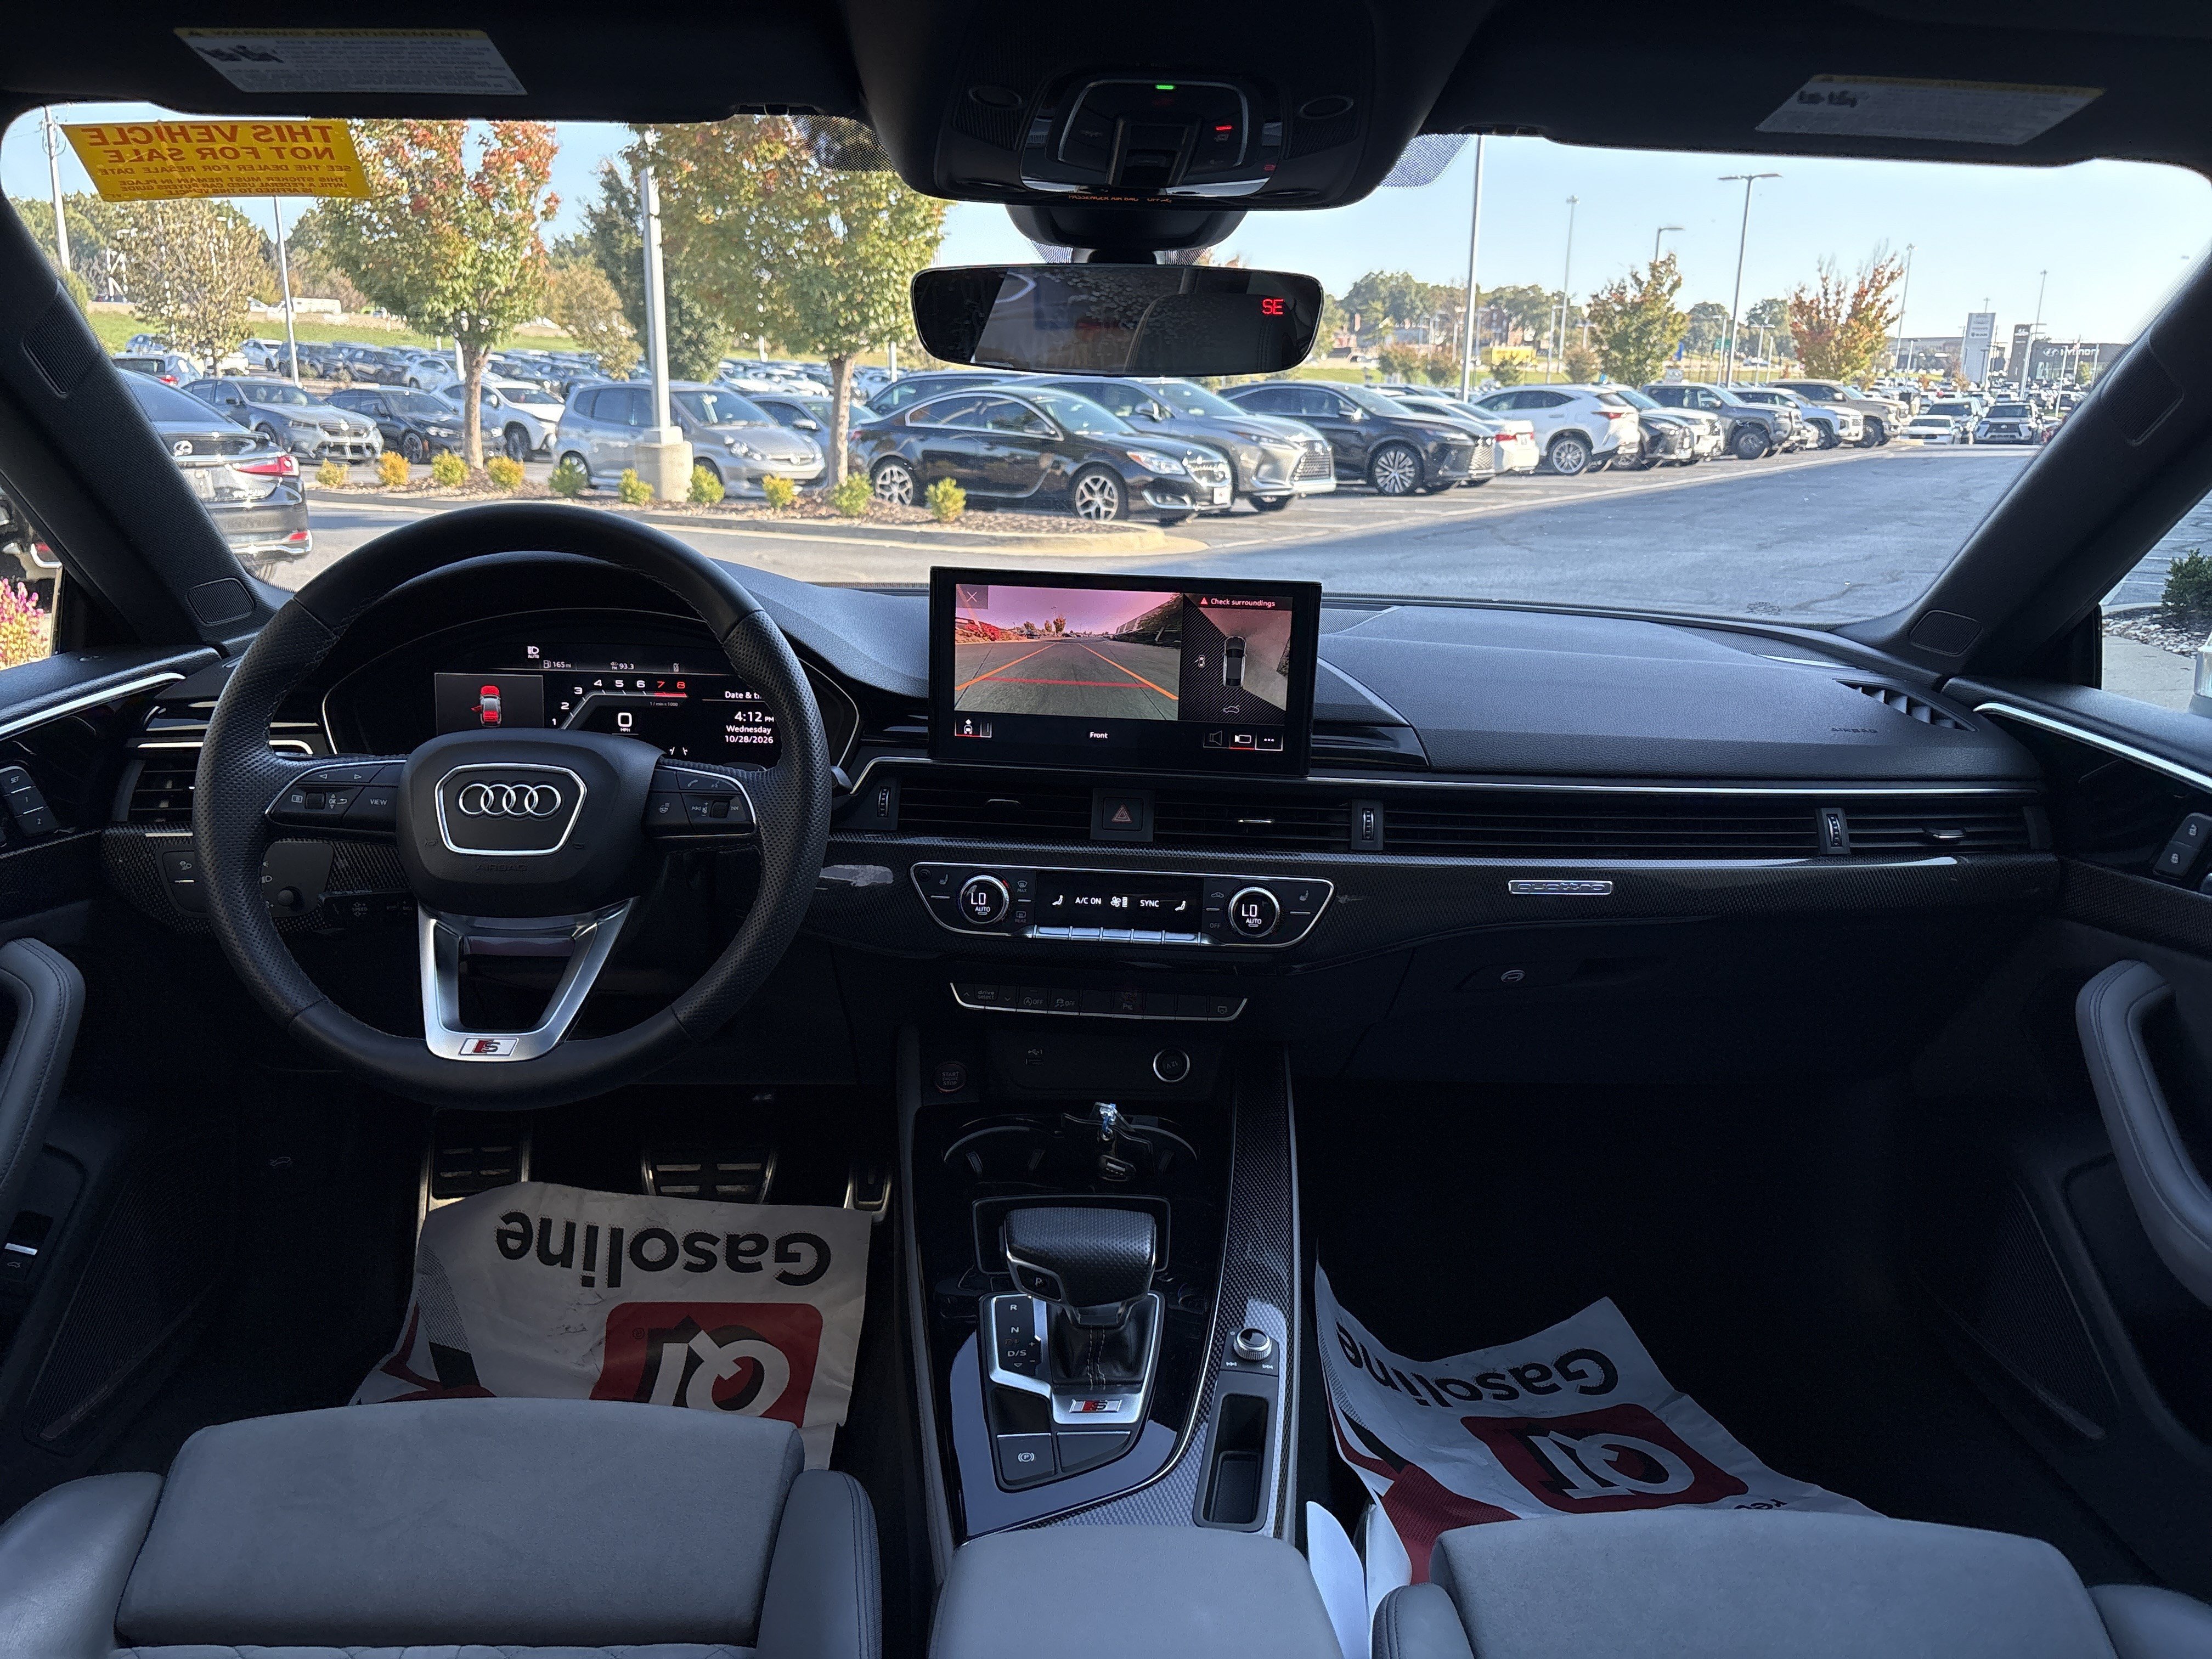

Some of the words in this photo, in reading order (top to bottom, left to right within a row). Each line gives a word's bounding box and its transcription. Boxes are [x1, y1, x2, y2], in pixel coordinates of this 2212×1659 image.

[1262, 298, 1284, 315] SE
[1232, 600, 1276, 608] surroundings
[618, 712, 632, 727] 0
[734, 711, 762, 722] 4:12
[726, 725, 771, 735] Wednesday
[725, 735, 774, 743] 10/28/2026
[1517, 883, 1605, 894] quattro
[496, 1209, 831, 1288] Gasoline
[1335, 1320, 1618, 1408] Gasoline
